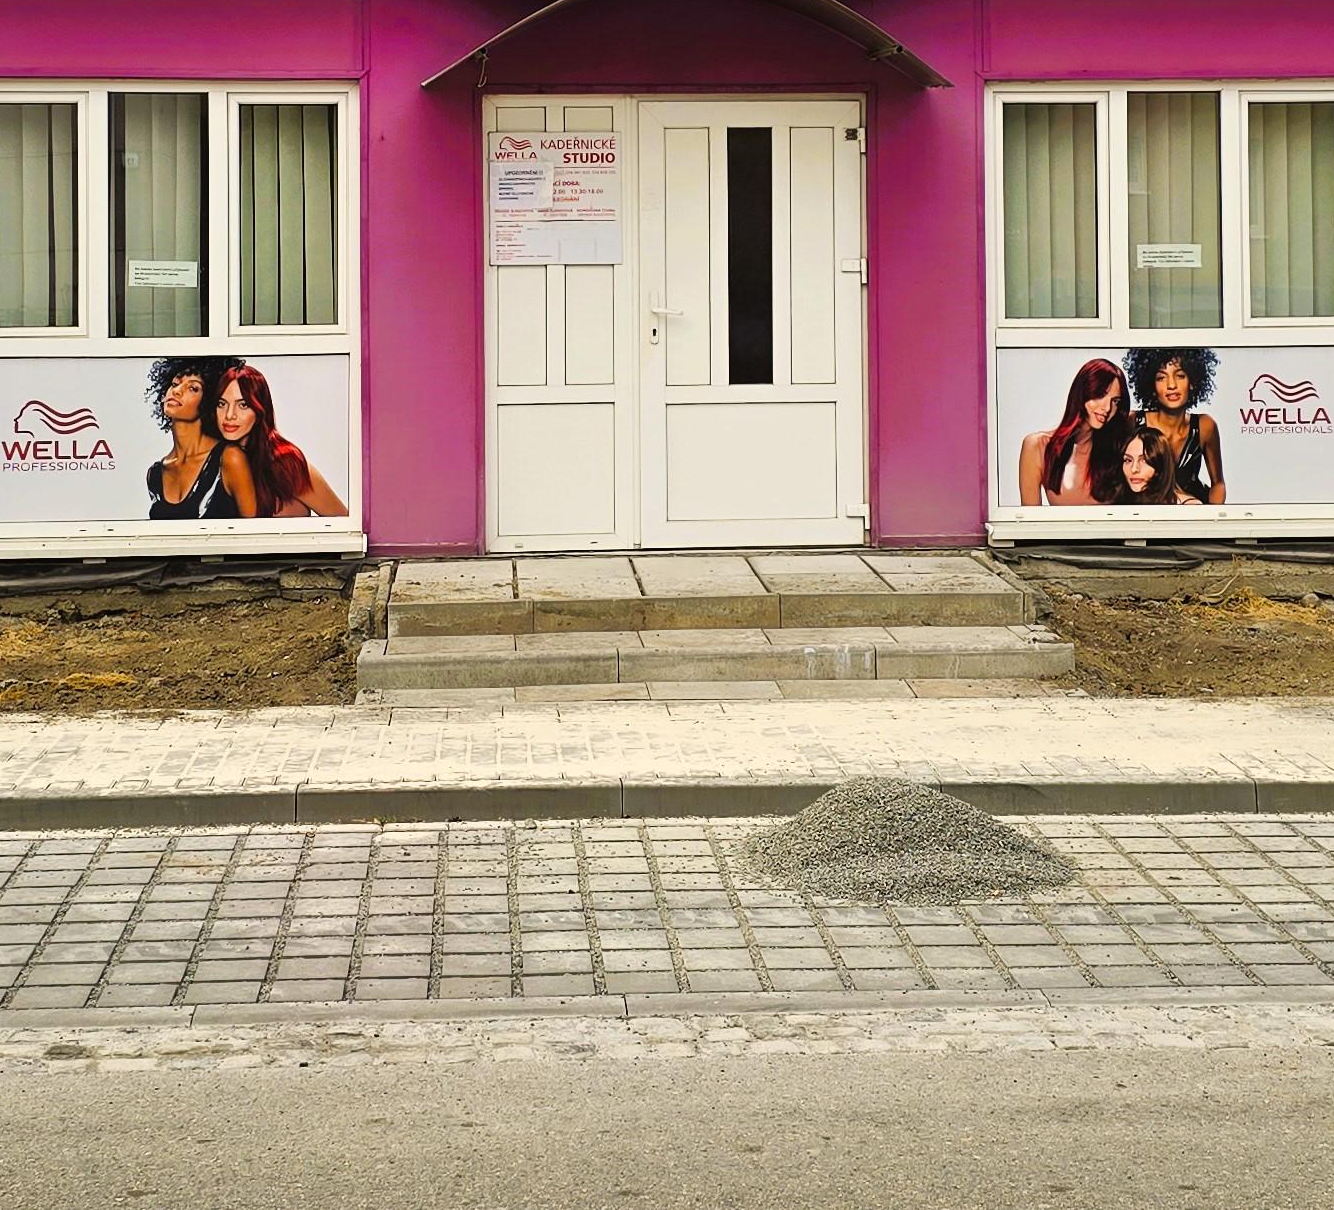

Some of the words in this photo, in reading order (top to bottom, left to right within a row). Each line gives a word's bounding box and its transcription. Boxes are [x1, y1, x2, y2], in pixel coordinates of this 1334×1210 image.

[540, 136, 616, 150] KADEŘNICKÉ
[495, 151, 538, 160] WELLA
[563, 152, 616, 164] STUDIO
[1239, 407, 1331, 425] WELLA
[1241, 425, 1334, 435] PROFESSIONALS
[1, 439, 114, 461] WELLA
[2, 461, 116, 472] PROFESSIONALS
